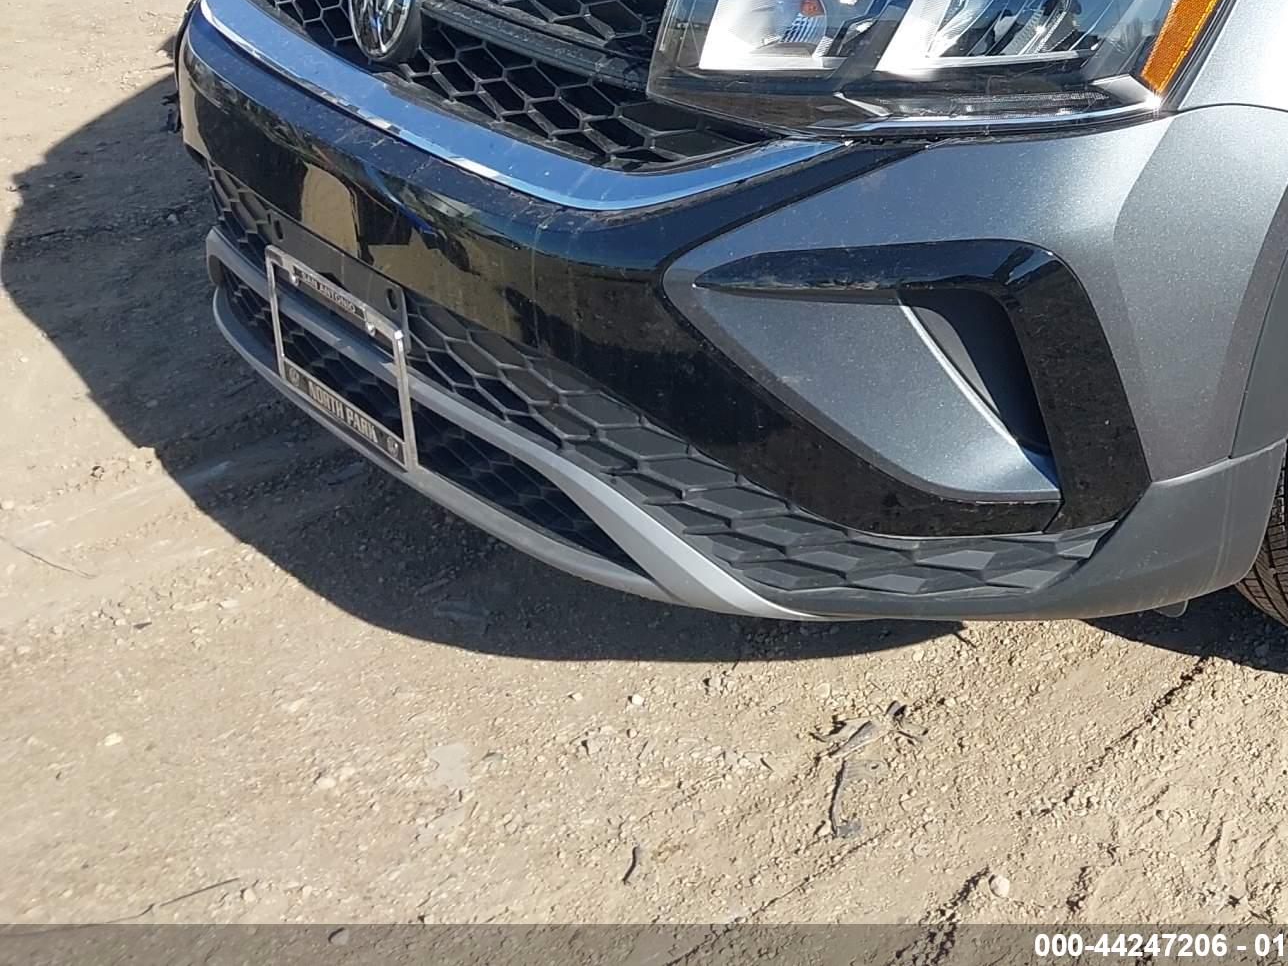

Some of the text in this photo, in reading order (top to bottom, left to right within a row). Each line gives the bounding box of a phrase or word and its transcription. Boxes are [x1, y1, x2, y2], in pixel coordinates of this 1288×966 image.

[301, 271, 357, 315] SAN ANTONIO
[308, 381, 379, 443] NORTH PARK
